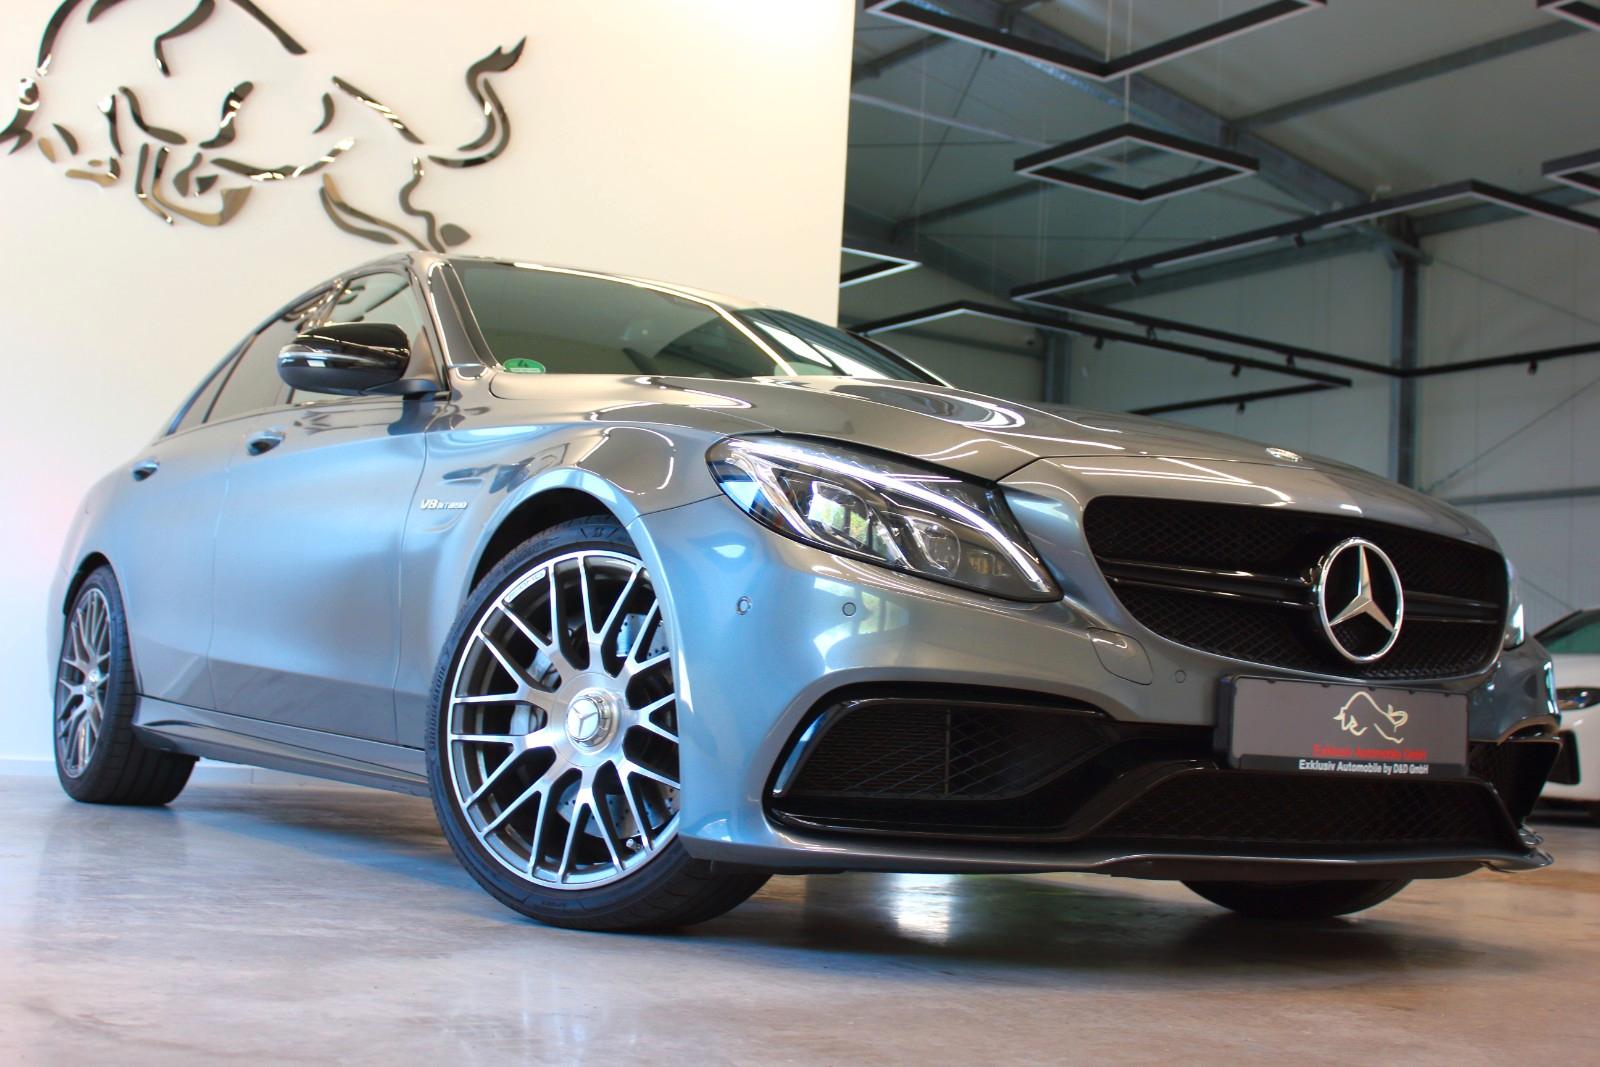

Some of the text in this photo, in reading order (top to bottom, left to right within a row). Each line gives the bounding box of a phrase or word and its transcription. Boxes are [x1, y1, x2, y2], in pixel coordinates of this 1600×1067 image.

[421, 499, 440, 509] V8
[1298, 759, 1429, 775] Exklusiv Automobile by D&D GmbH
